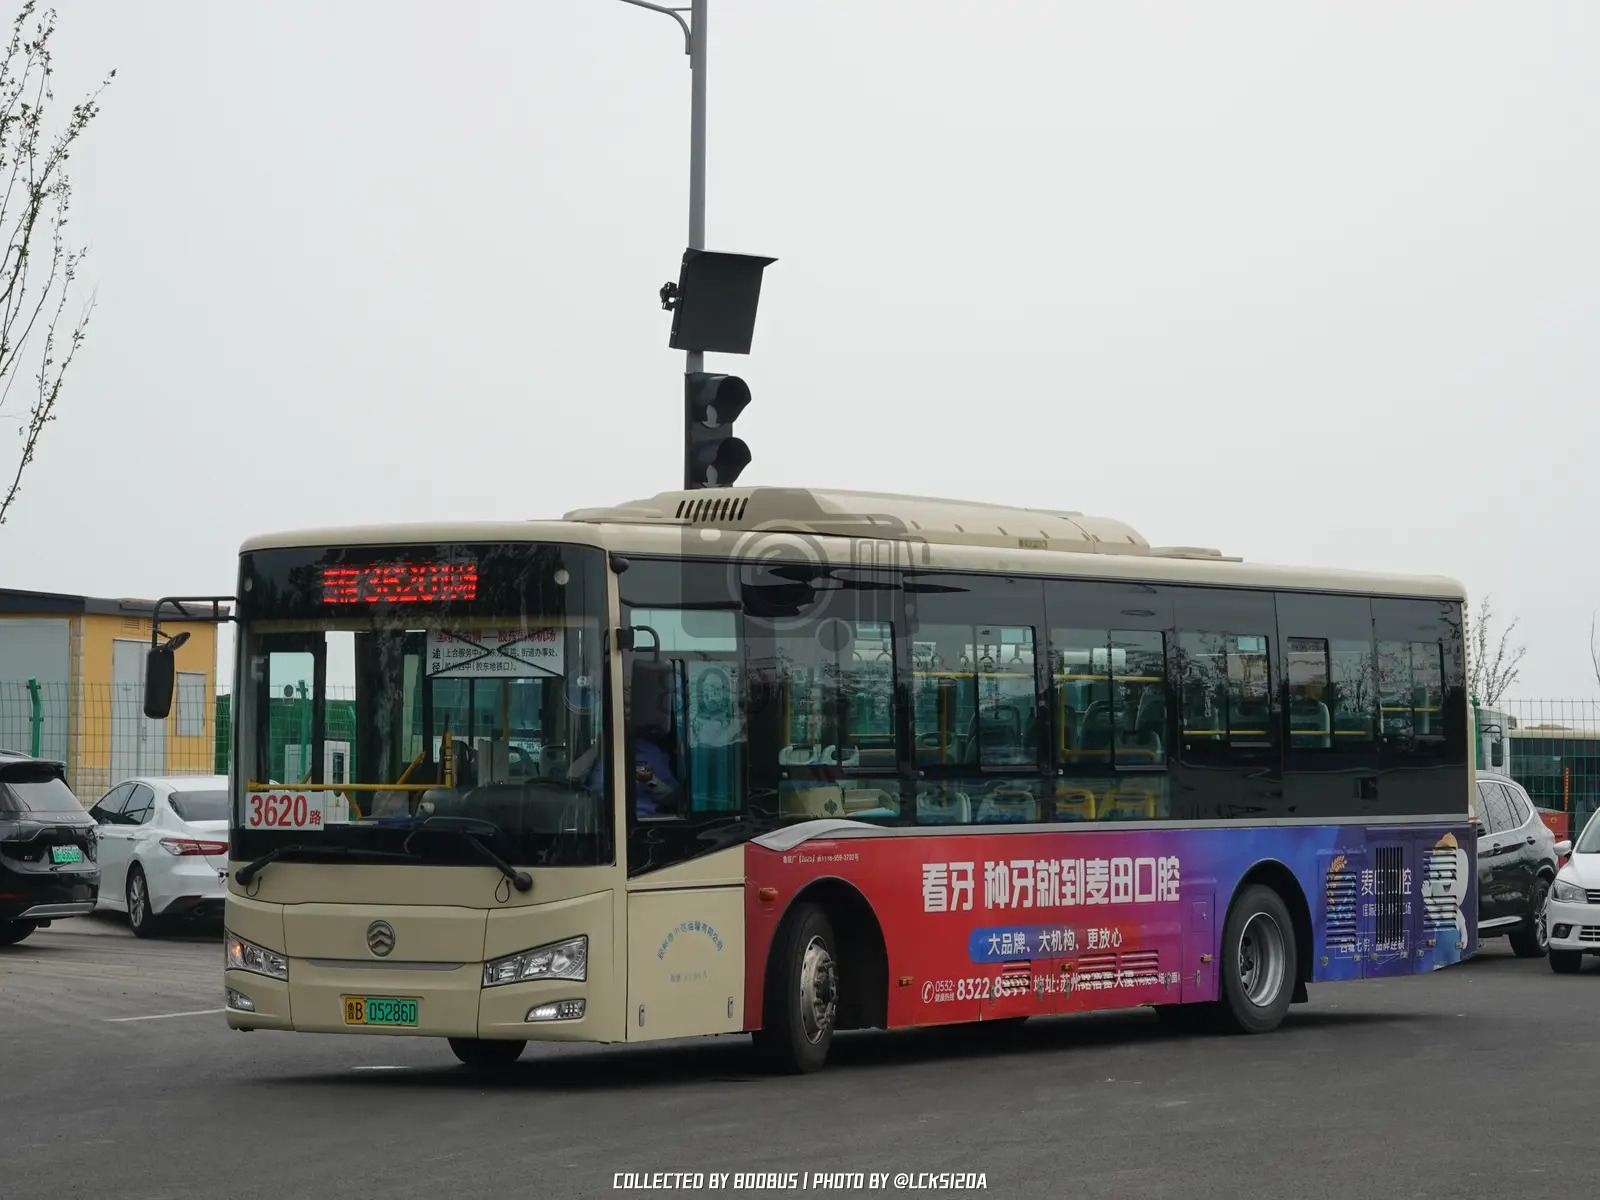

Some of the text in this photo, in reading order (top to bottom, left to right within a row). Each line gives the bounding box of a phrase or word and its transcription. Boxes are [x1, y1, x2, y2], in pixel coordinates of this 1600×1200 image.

[249, 794, 322, 827] 3620路
[922, 856, 1181, 912] 看牙 种牙就到麦田口腔
[956, 978, 990, 1001] 8322
[369, 1002, 416, 1022] 05286D
